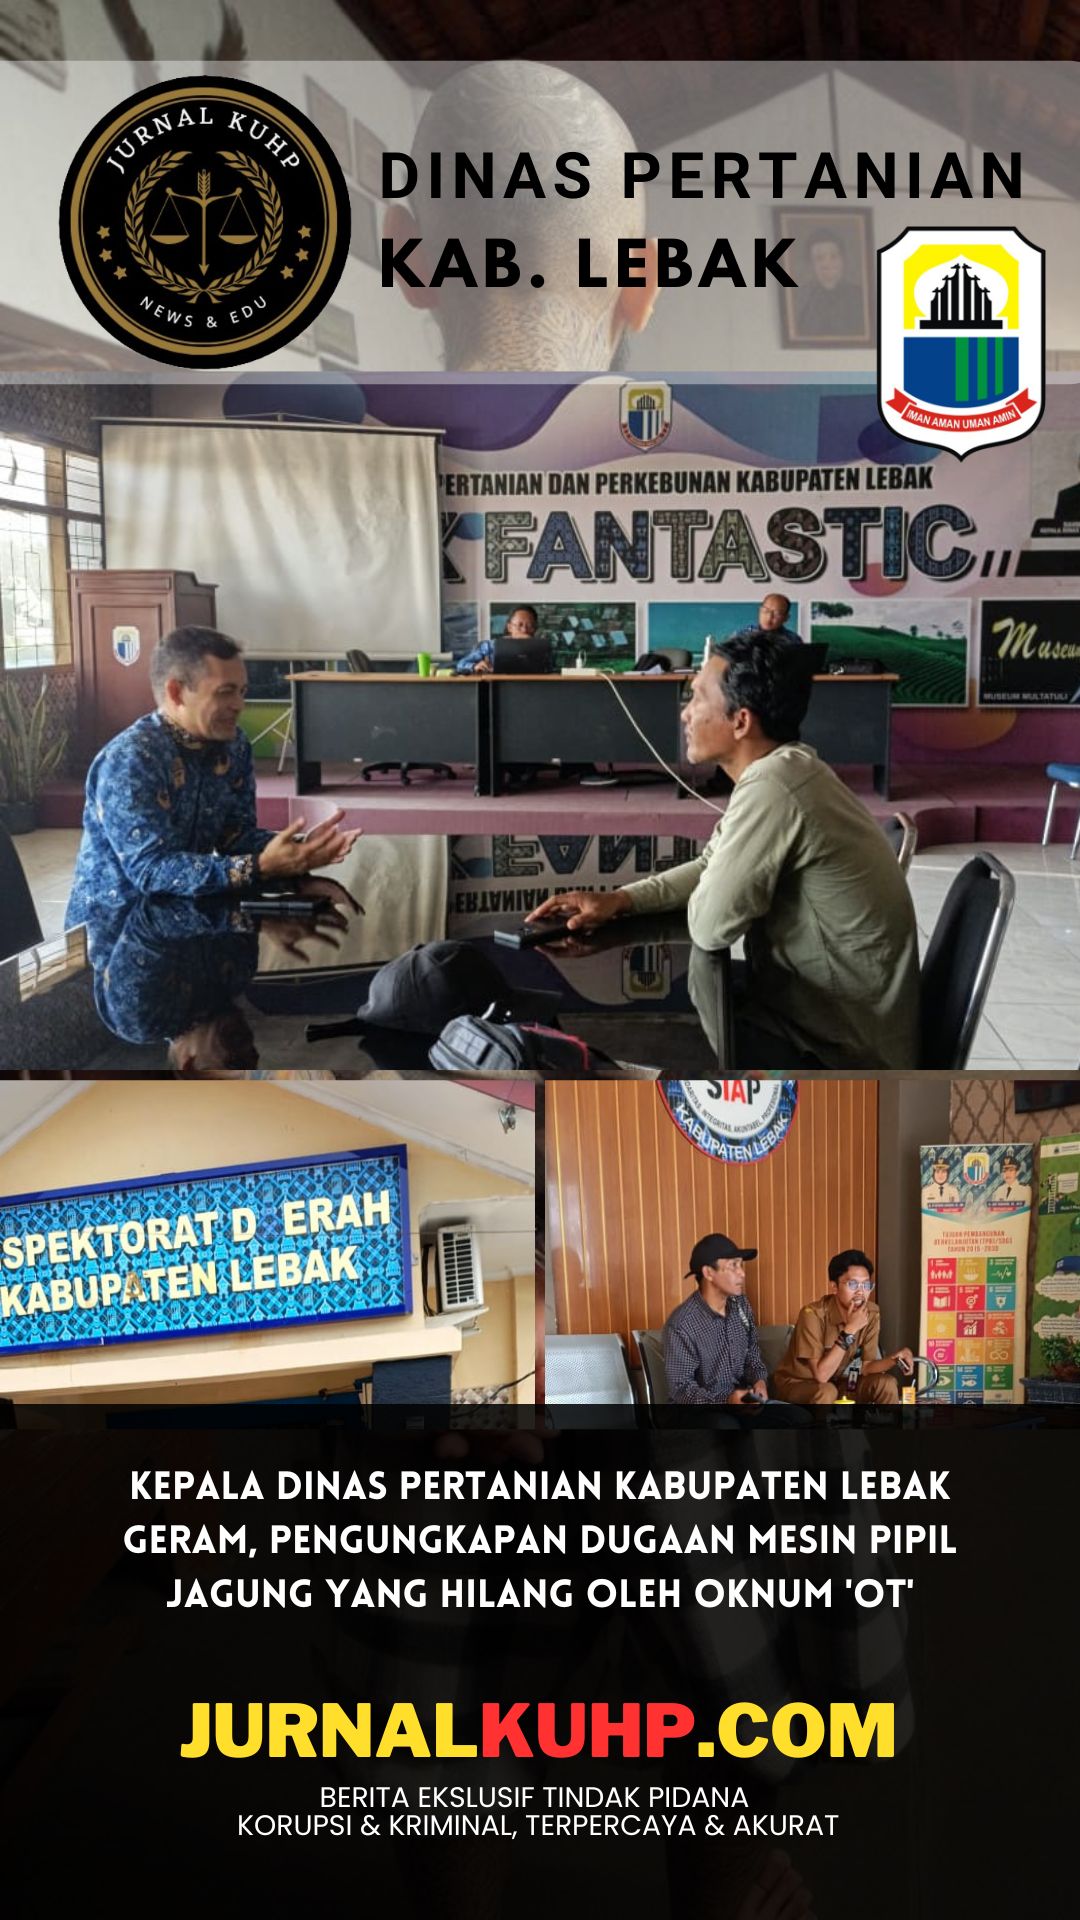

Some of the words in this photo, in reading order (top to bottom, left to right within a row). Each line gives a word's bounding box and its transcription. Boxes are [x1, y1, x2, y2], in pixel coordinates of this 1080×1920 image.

[439, 472, 542, 496] ERTANIAN
[549, 472, 590, 496] DAN
[596, 469, 731, 495] PERKEBUNAN
[736, 467, 860, 494] KABUPATEN
[865, 466, 934, 491] LEBAK
[484, 503, 978, 585] FANTASTIC
[706, 1080, 761, 1105] SIAP
[674, 1103, 753, 1160] KABUPATEN
[754, 1113, 789, 1156] LEBAK
[0, 1211, 219, 1271] SPEKTORAT
[0, 1260, 218, 1318] KABUPATEN
[231, 1245, 359, 1293] LEBAK
